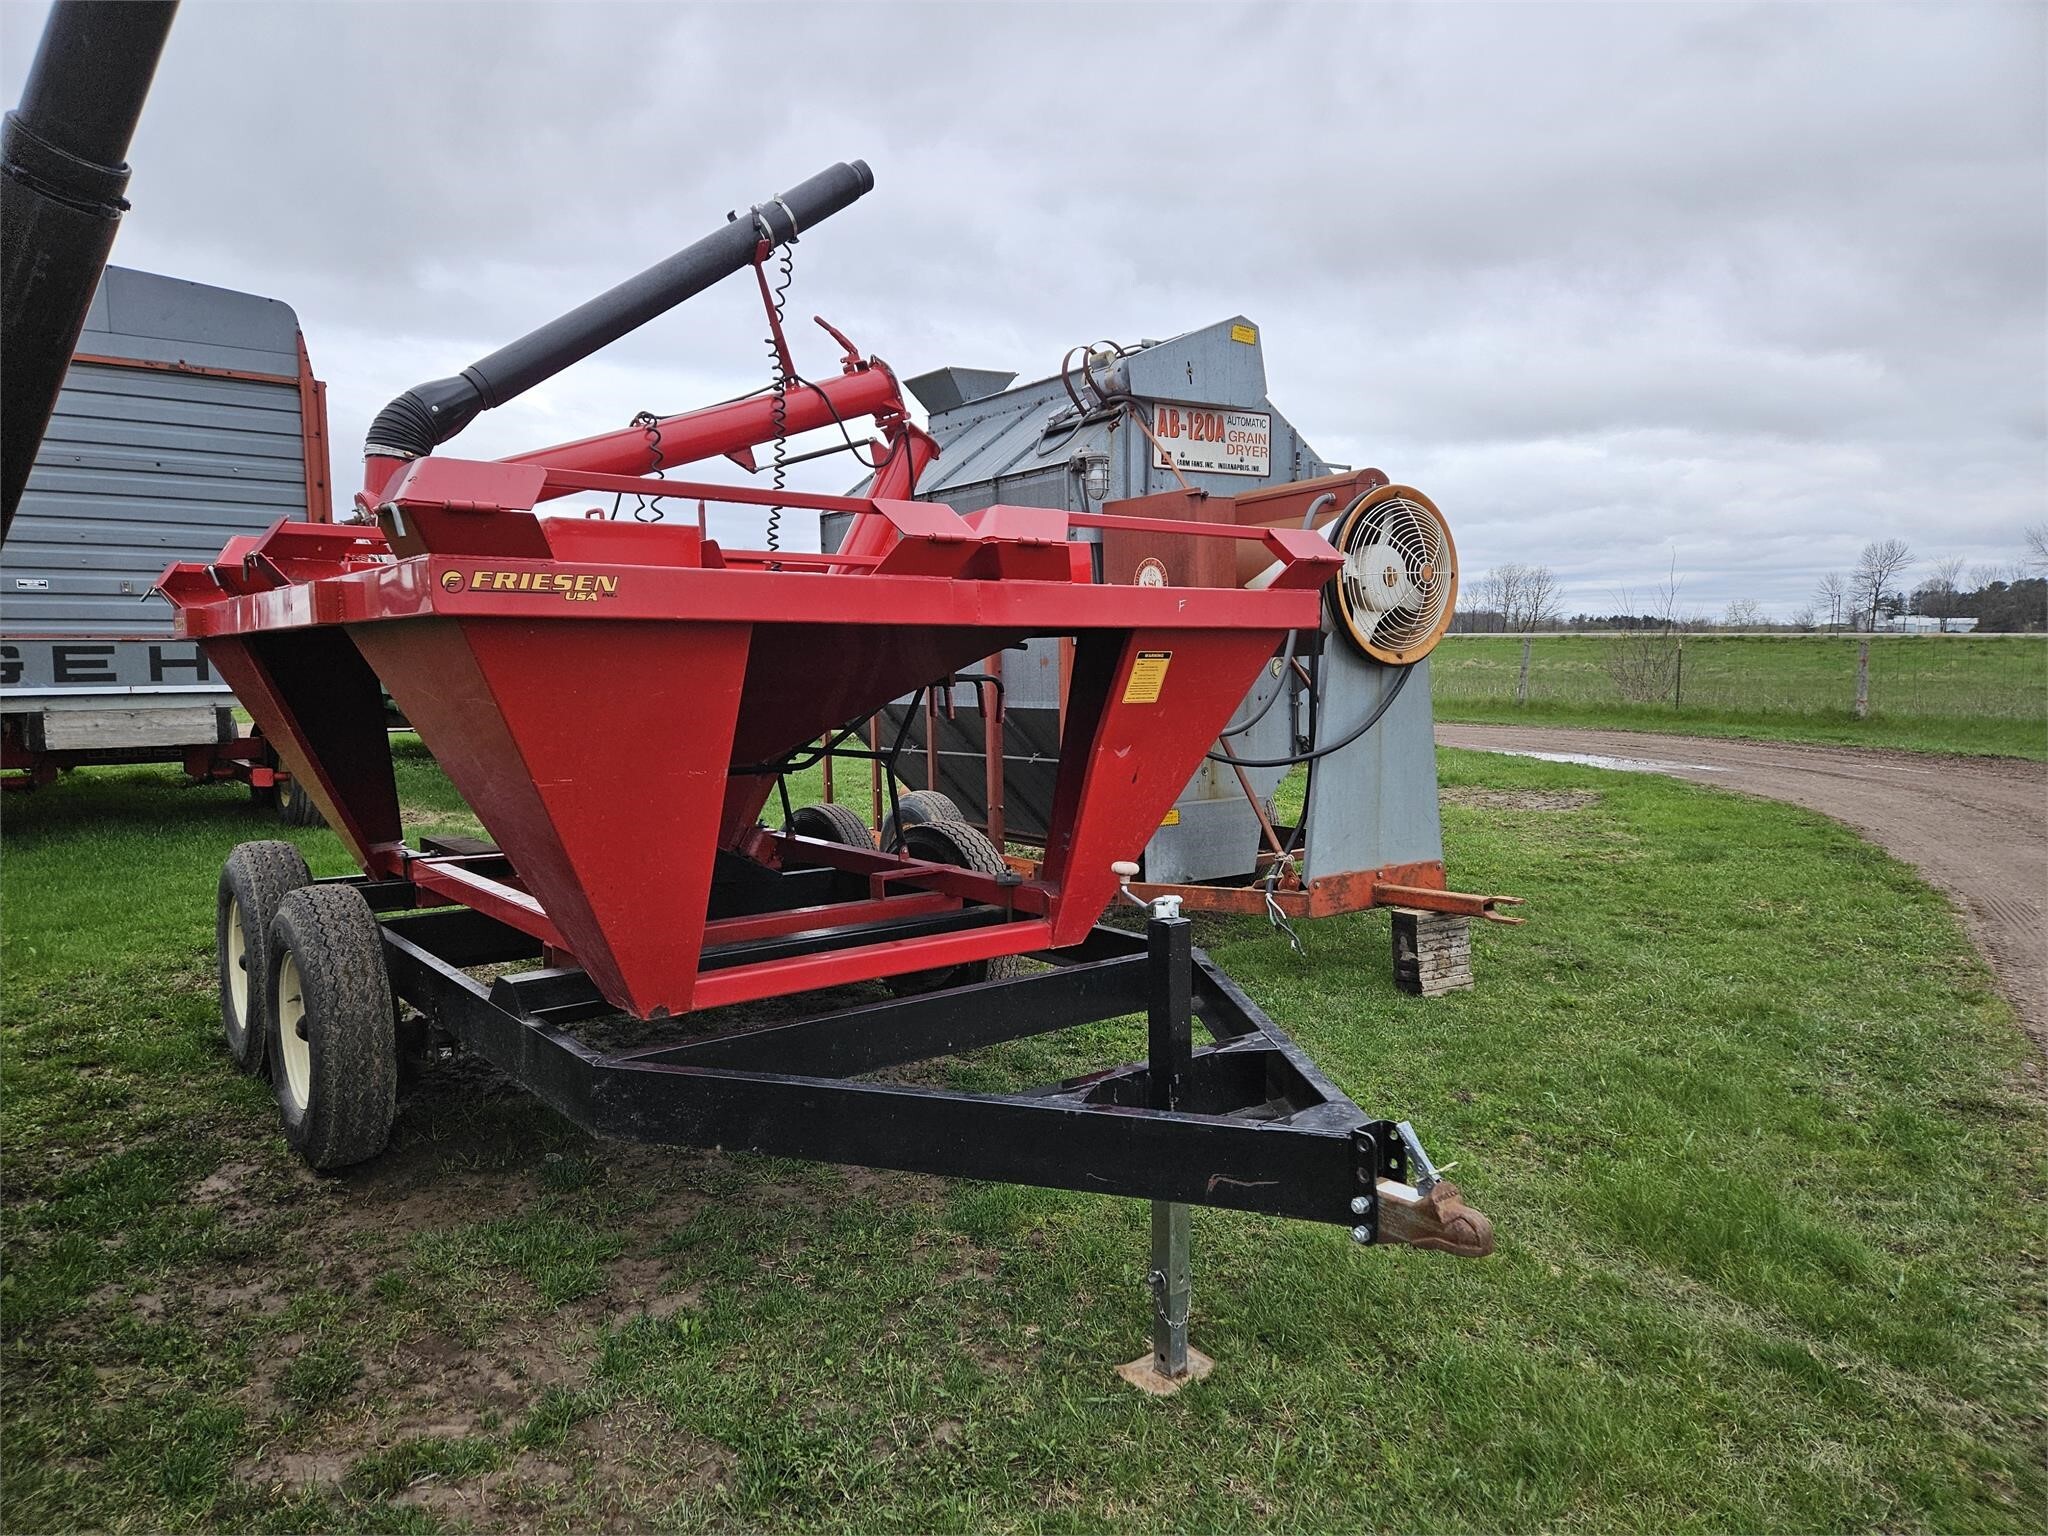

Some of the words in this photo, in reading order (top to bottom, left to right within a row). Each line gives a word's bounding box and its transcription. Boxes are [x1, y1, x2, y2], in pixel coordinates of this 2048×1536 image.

[1157, 408, 1225, 442] AB-120A
[1227, 415, 1266, 429] AUTOMATIC
[1228, 430, 1267, 445] GRAIN
[1226, 444, 1268, 458] DRYER
[1176, 459, 1190, 467] FARM
[470, 570, 619, 592] FRIESEN
[564, 591, 598, 602] USA
